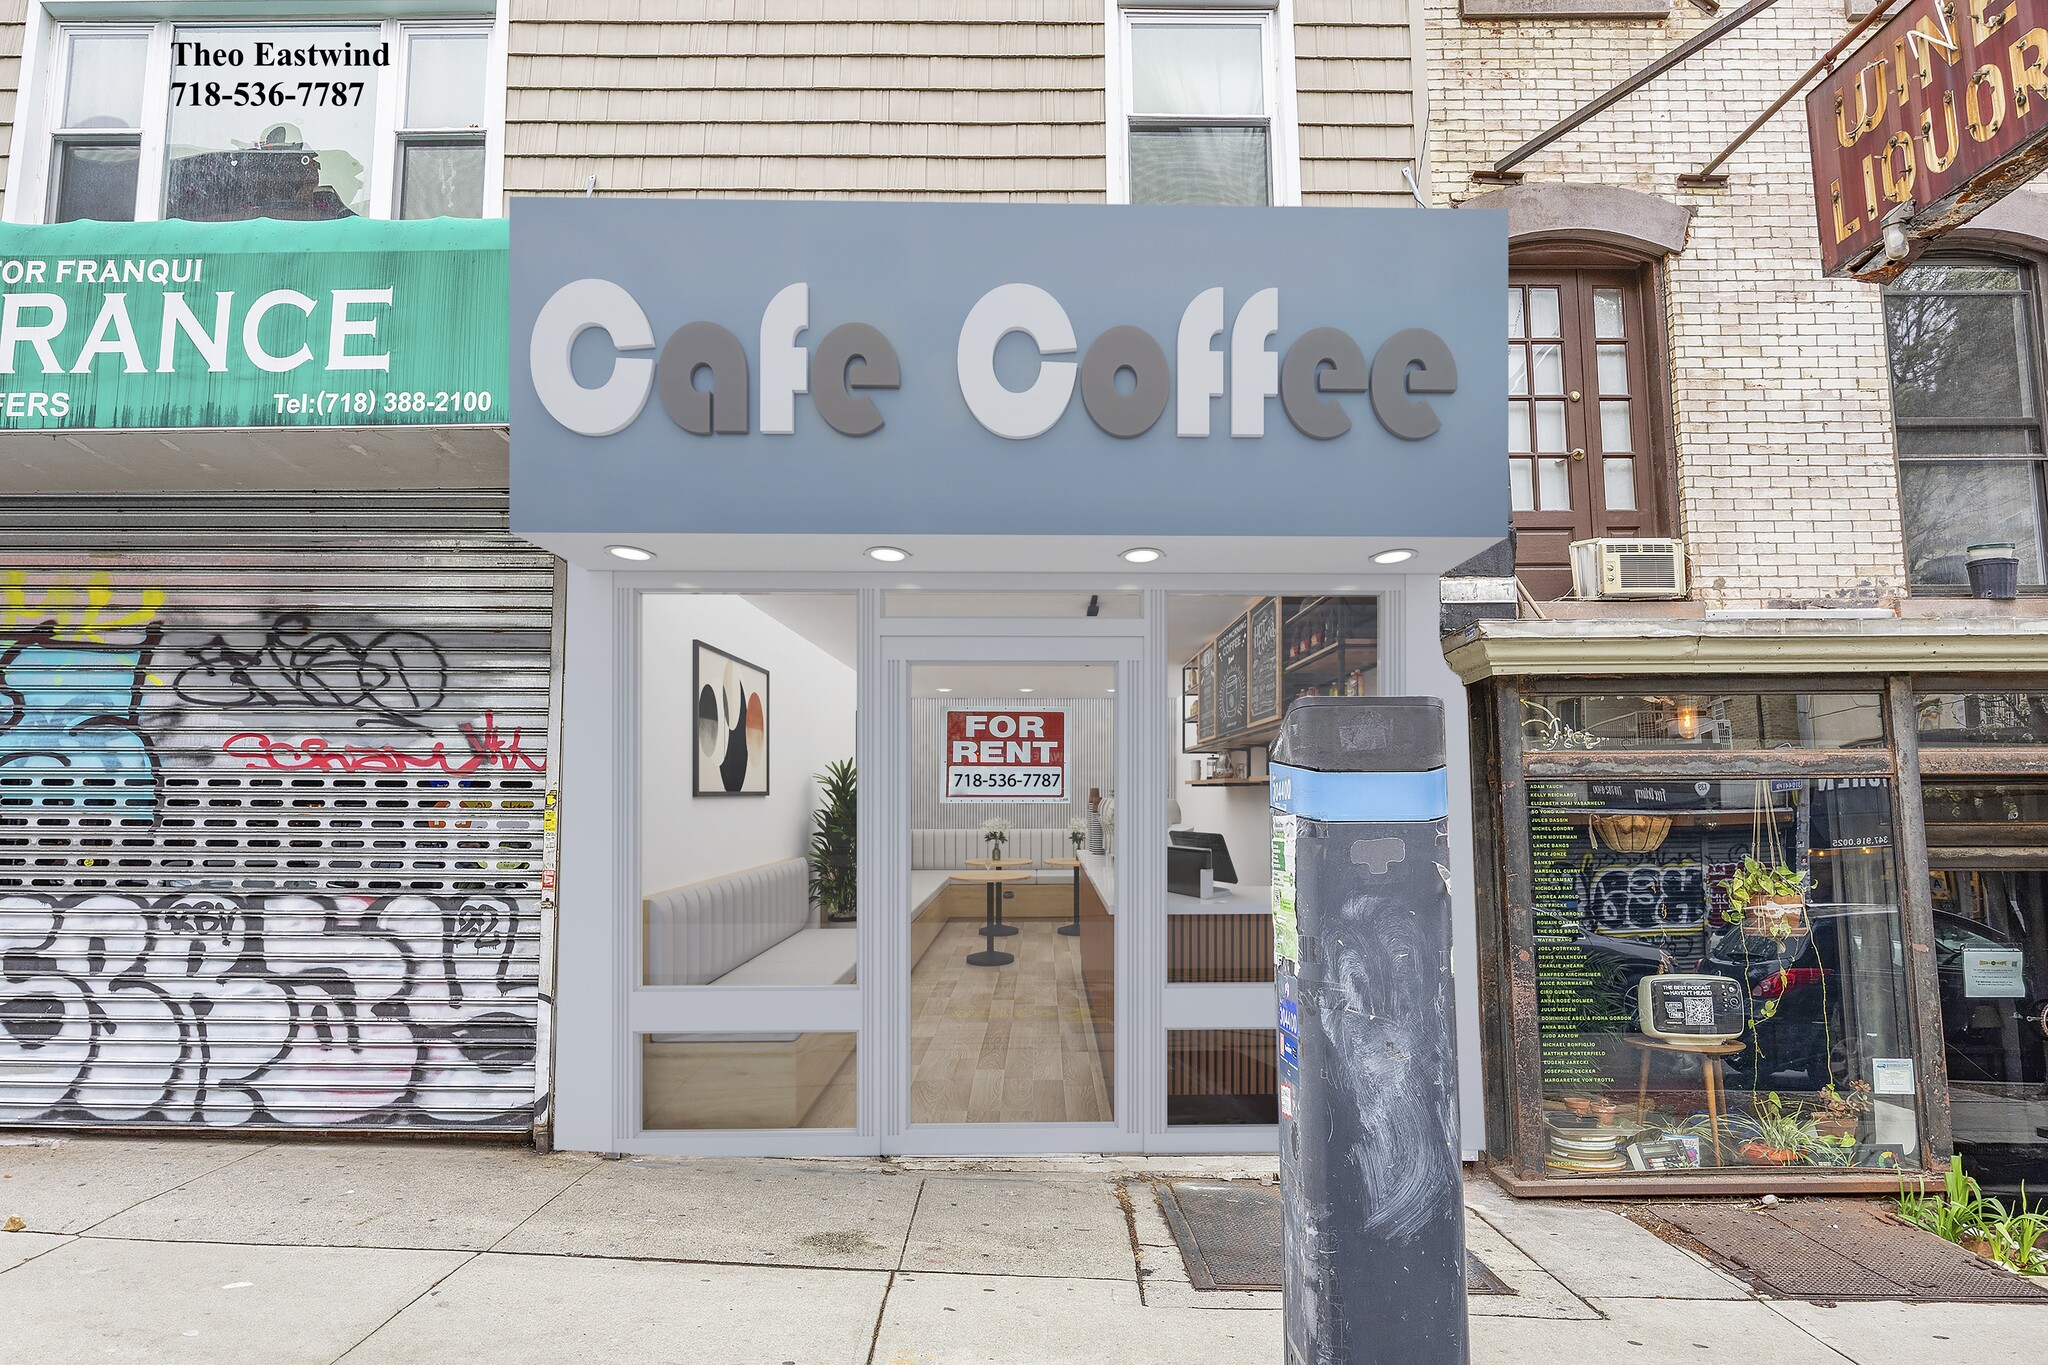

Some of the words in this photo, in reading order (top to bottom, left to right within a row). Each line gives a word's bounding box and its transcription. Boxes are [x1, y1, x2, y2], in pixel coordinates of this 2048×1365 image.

[1830, 28, 2048, 245] LIQUOR
[0, 259, 47, 284] OR
[56, 258, 203, 286] FRANQUI
[0, 285, 394, 374] RANCE
[529, 277, 902, 438] Cafe
[956, 282, 1459, 442] Coffee
[273, 389, 376, 417] Tel:(718)
[383, 390, 492, 413] 388-2100
[1222, 634, 1242, 656] COFFEE
[965, 715, 1045, 738] FOR
[952, 741, 1058, 763] RENT
[954, 774, 1060, 787] 718-536-7787
[1279, 1006, 1298, 1034] 304400
